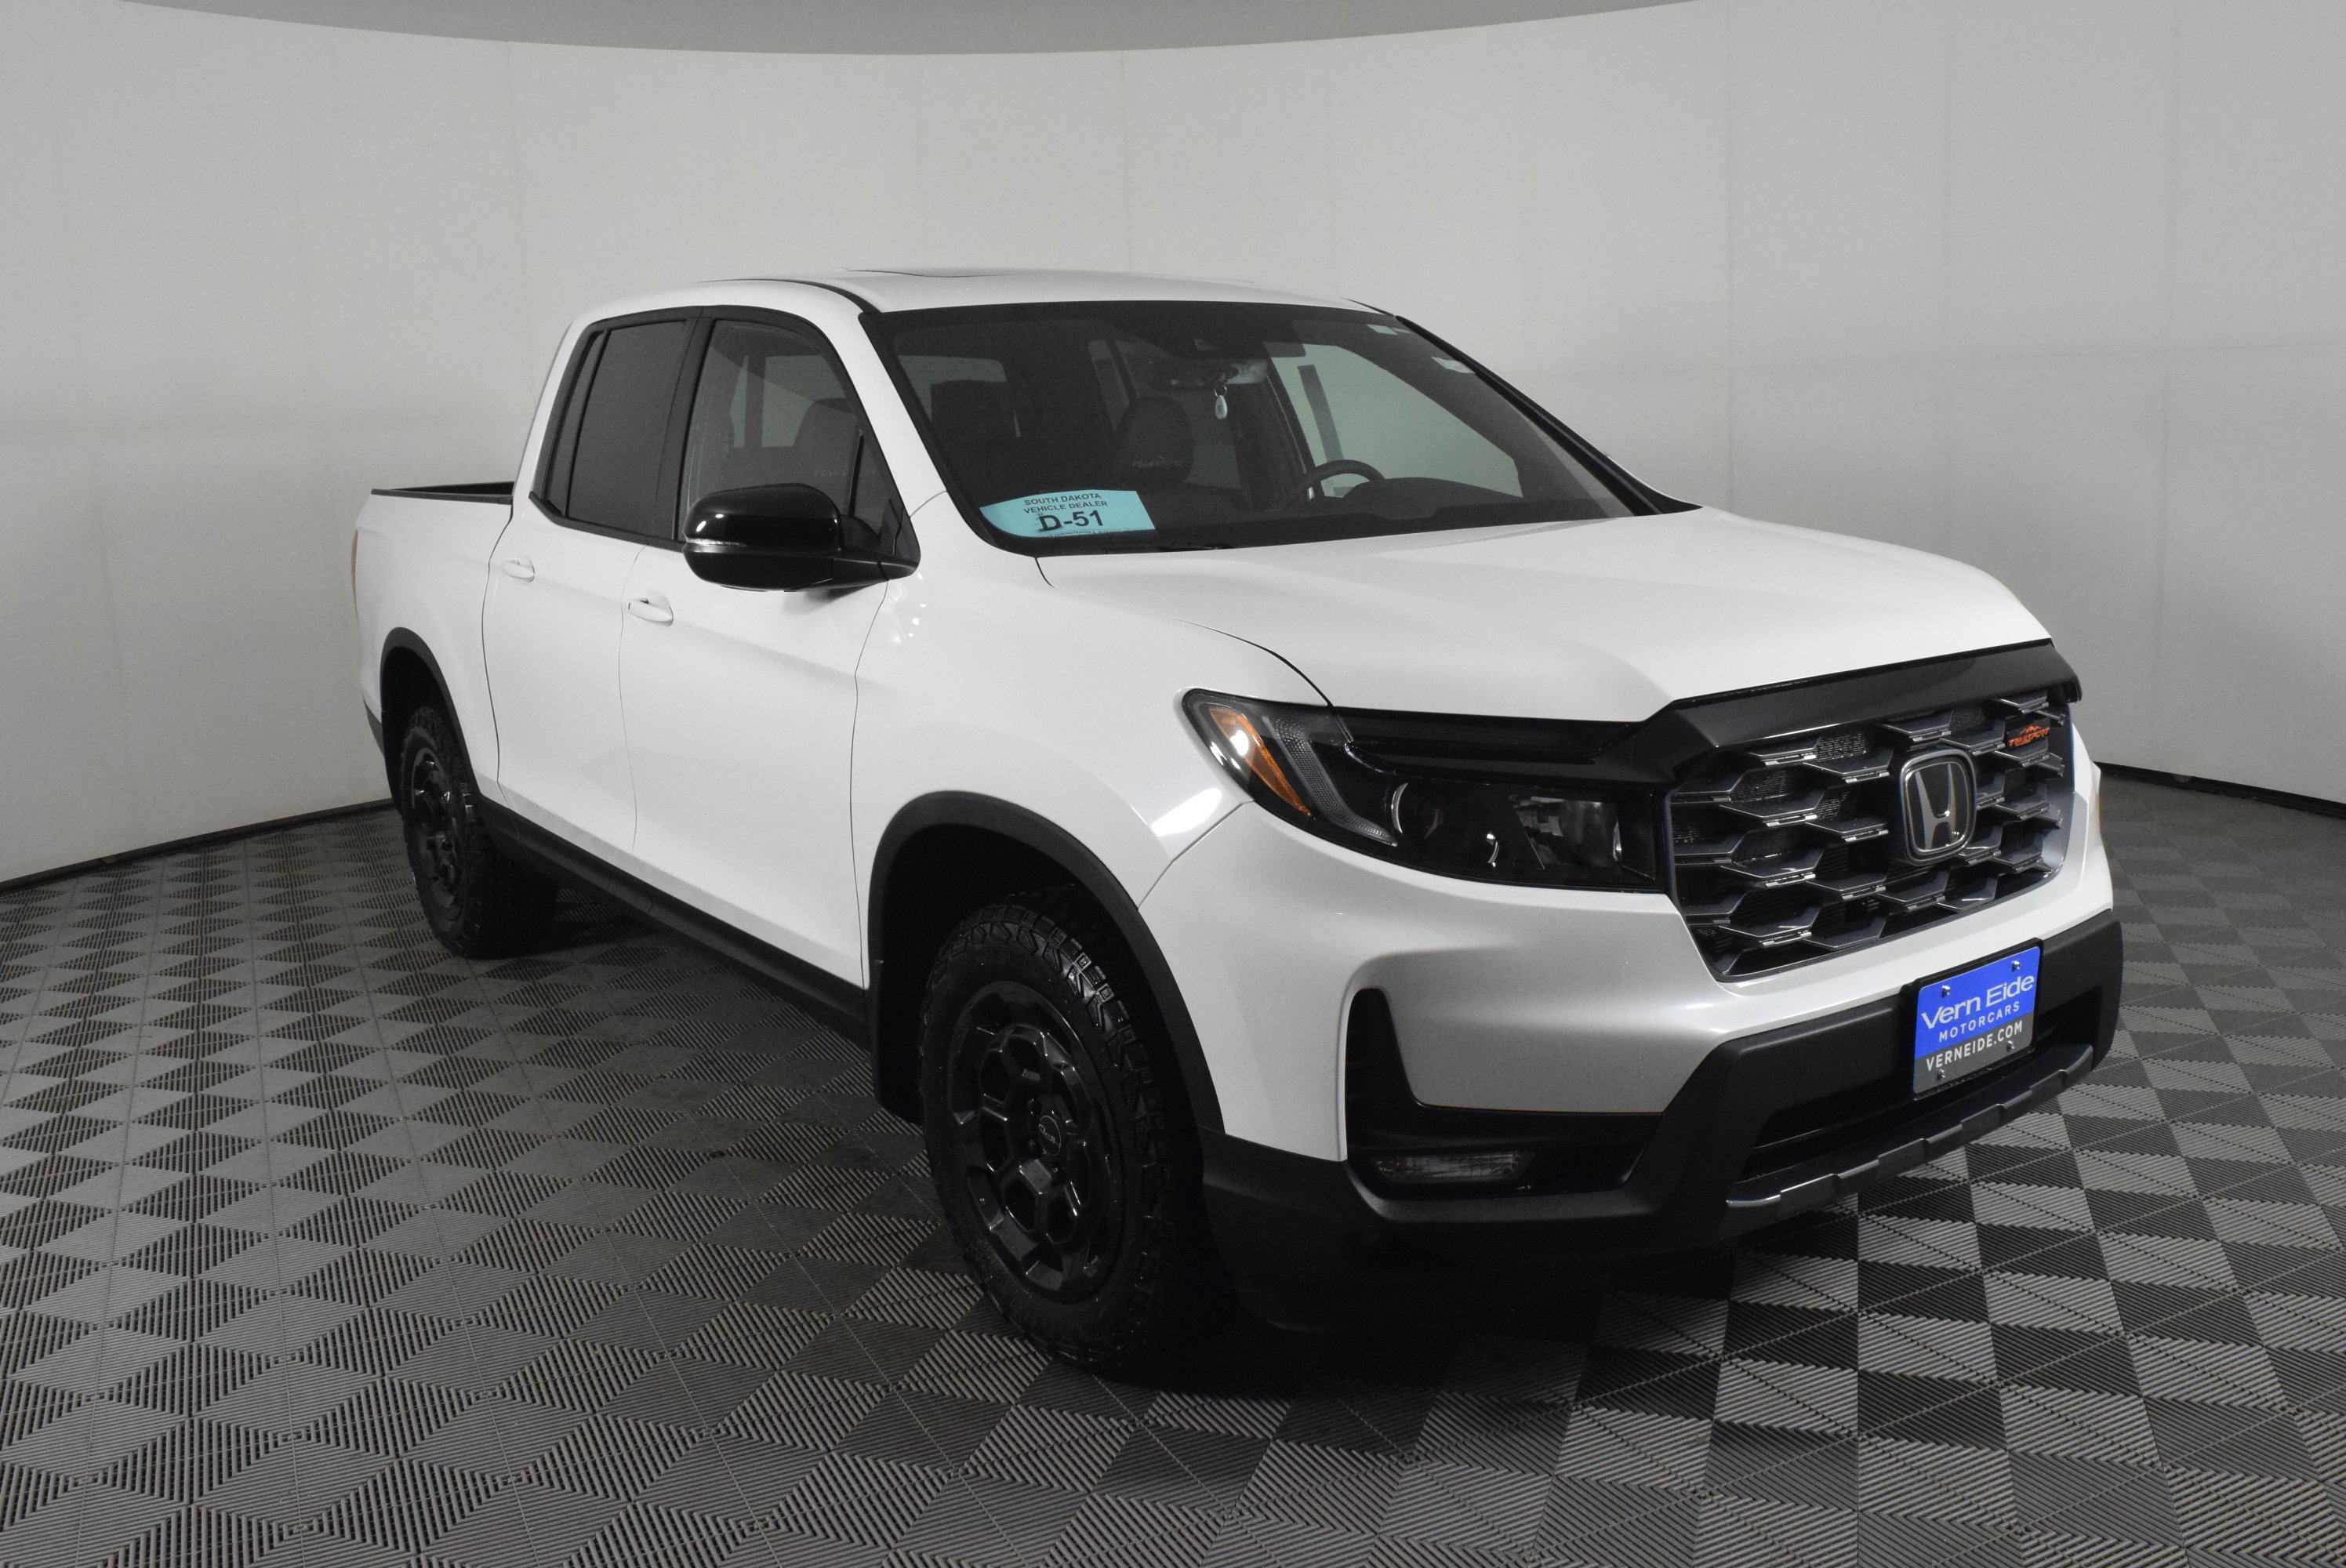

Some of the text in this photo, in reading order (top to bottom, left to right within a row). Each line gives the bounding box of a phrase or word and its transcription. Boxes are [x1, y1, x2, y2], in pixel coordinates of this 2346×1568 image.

[1023, 500, 1109, 514] VEHICLE DEALER
[1024, 493, 1102, 506] SOUTH DAKOTA
[1038, 510, 1103, 532] D-51
[1921, 975, 2035, 1029] Vern Eide
[1938, 1001, 2020, 1043] MOTORCARS
[1926, 1020, 2023, 1071] VERNEIDE.COM
